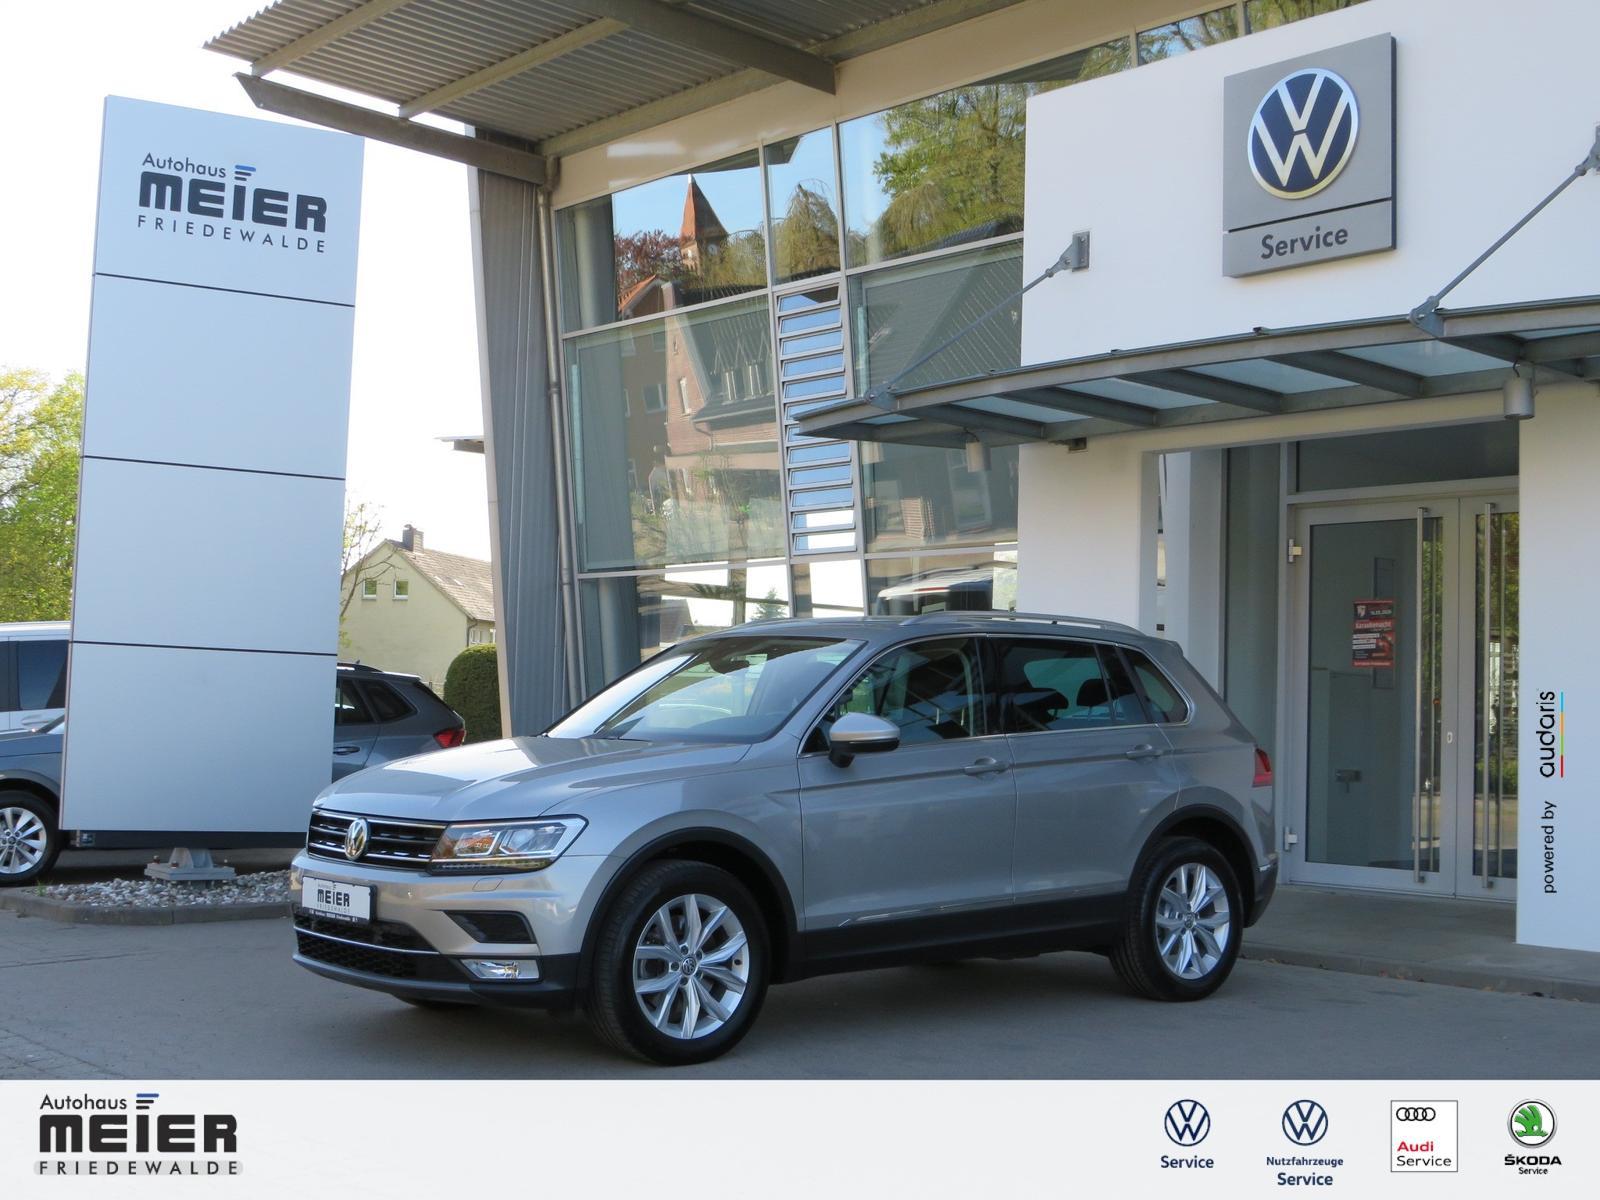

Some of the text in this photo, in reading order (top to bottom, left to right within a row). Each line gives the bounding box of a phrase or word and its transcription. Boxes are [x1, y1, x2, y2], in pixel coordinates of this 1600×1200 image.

[142, 152, 226, 178] Autohaus
[138, 170, 327, 233] MEIER
[137, 214, 325, 253] FRIEDEWALDE
[1261, 226, 1349, 260] Service
[318, 889, 350, 907] MEIER
